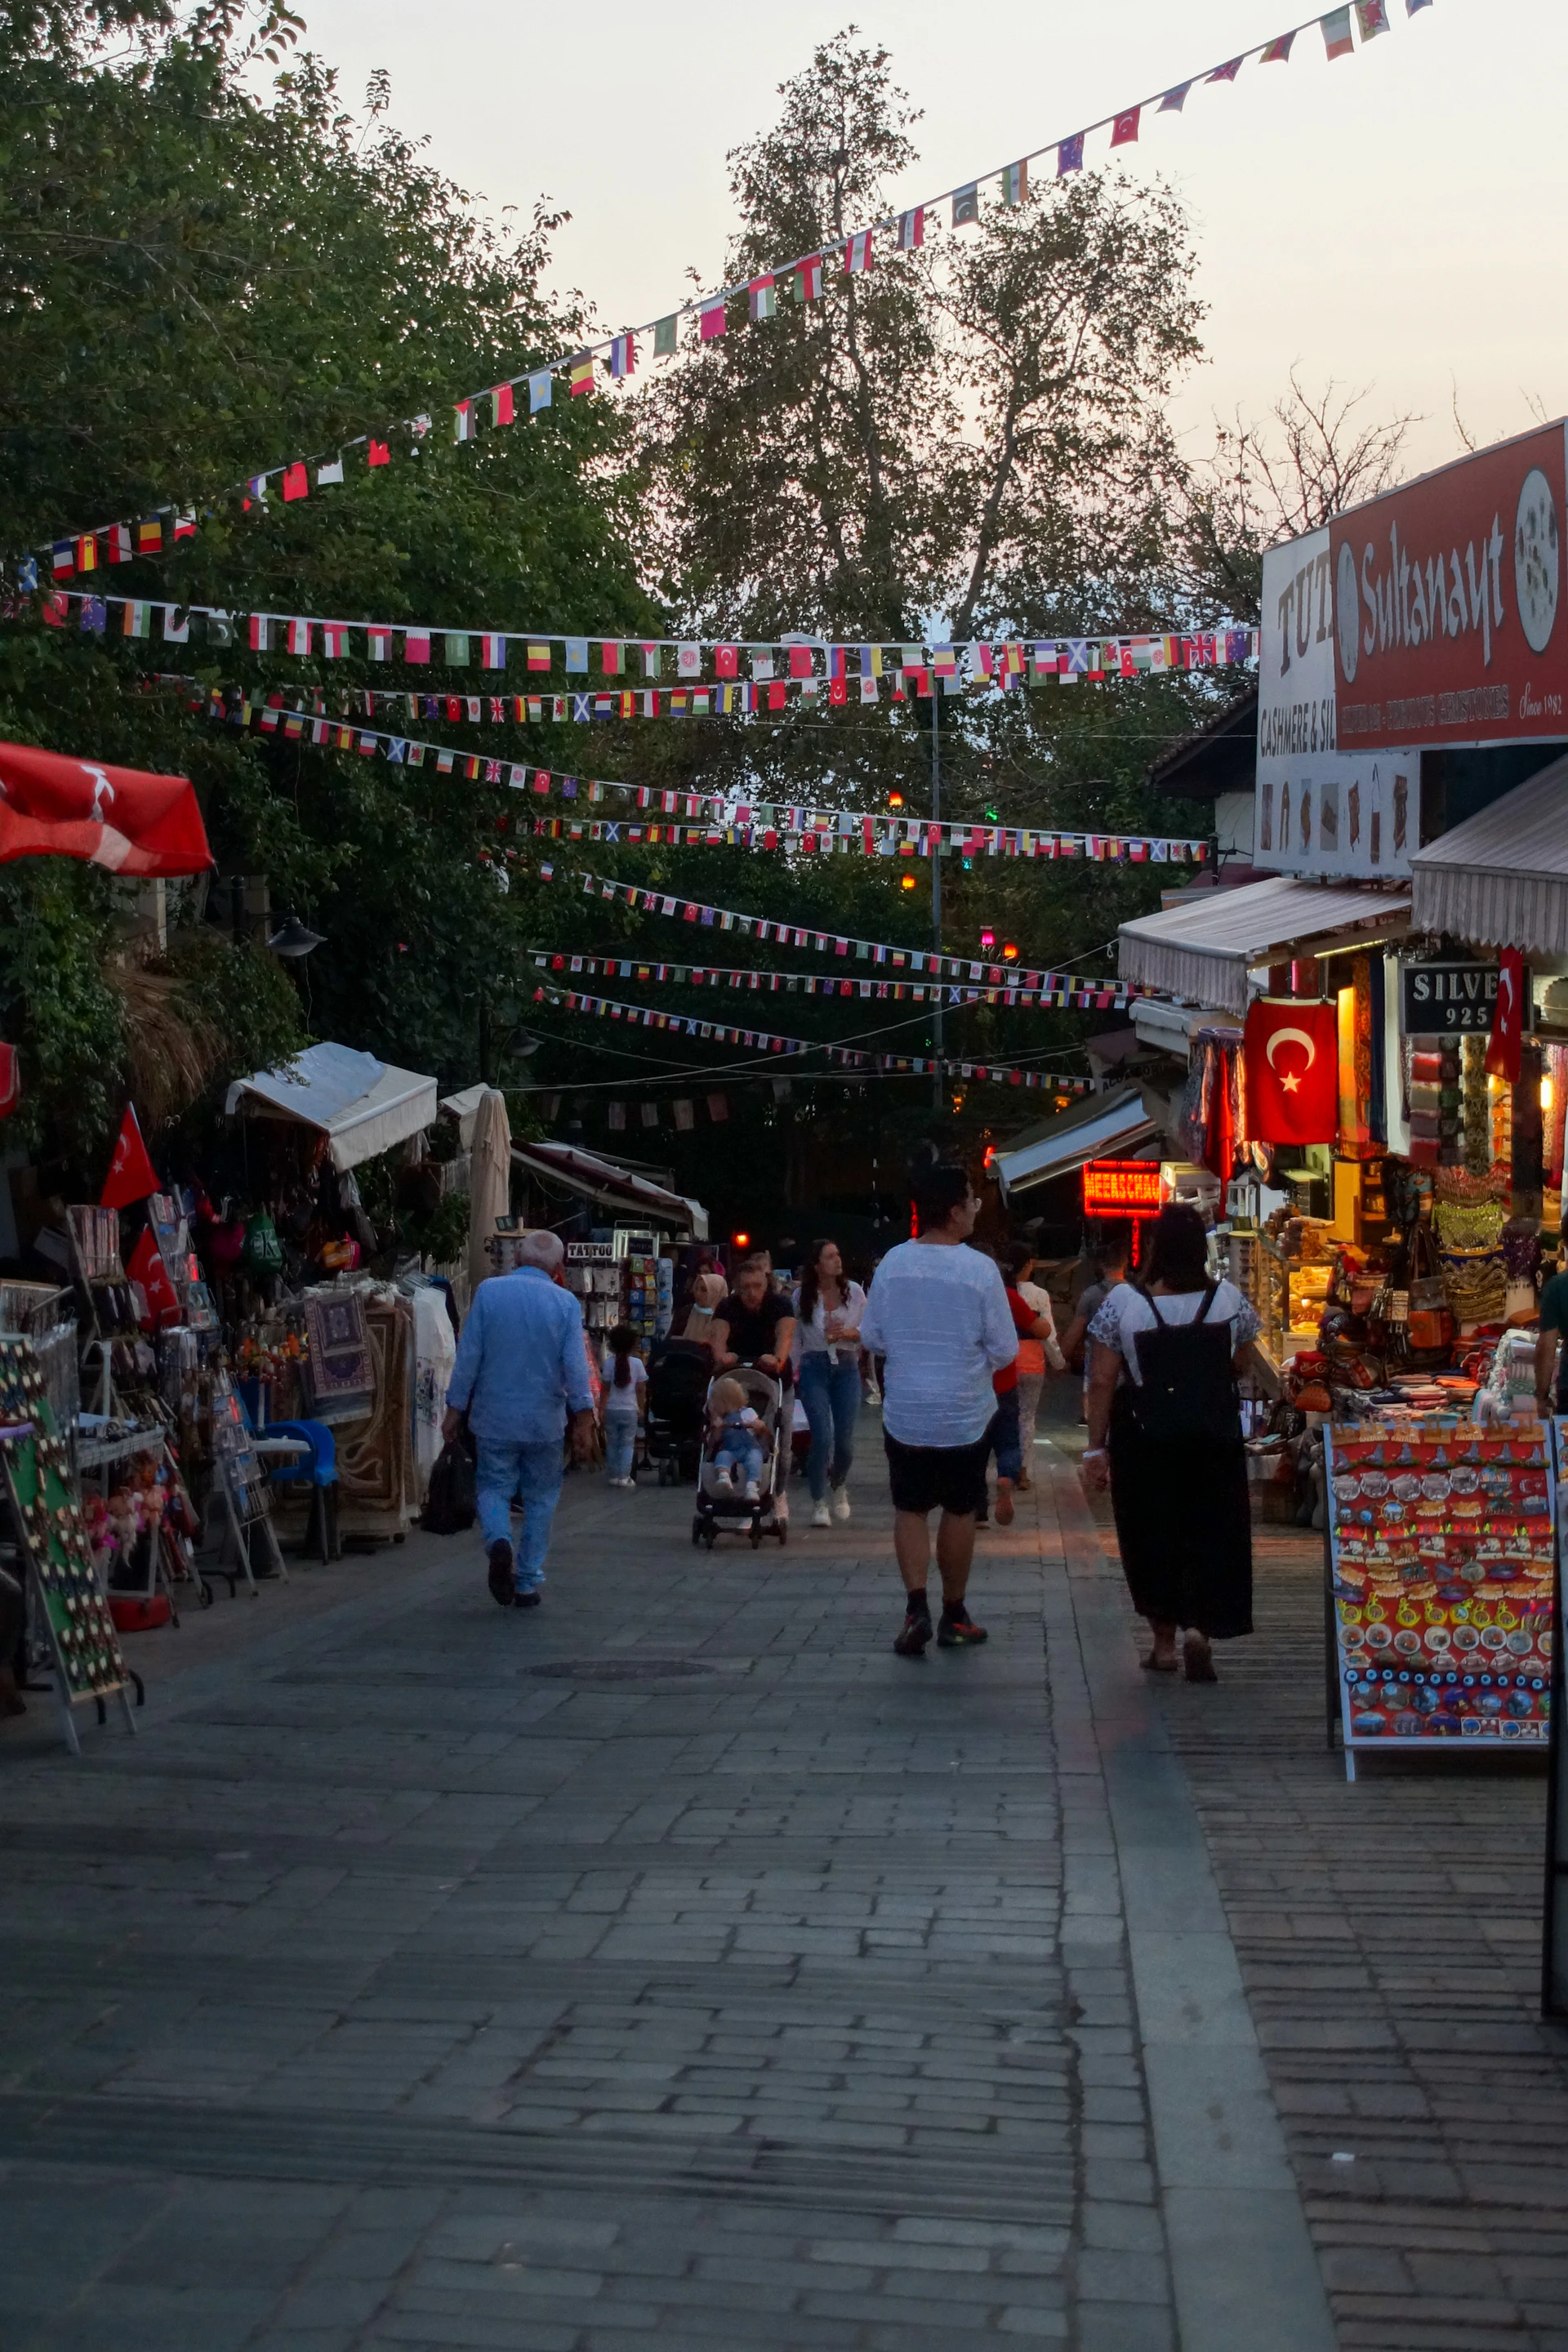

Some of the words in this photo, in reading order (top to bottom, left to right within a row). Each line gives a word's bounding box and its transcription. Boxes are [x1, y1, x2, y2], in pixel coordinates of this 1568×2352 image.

[1278, 550, 1334, 679] TUT
[1519, 681, 1542, 719] Since
[1544, 694, 1562, 716] 1982
[1260, 702, 1309, 757] CASHMERE
[1311, 700, 1317, 754] &
[1446, 1007, 1487, 1025] 925
[568, 1244, 612, 1257] TATTOO
